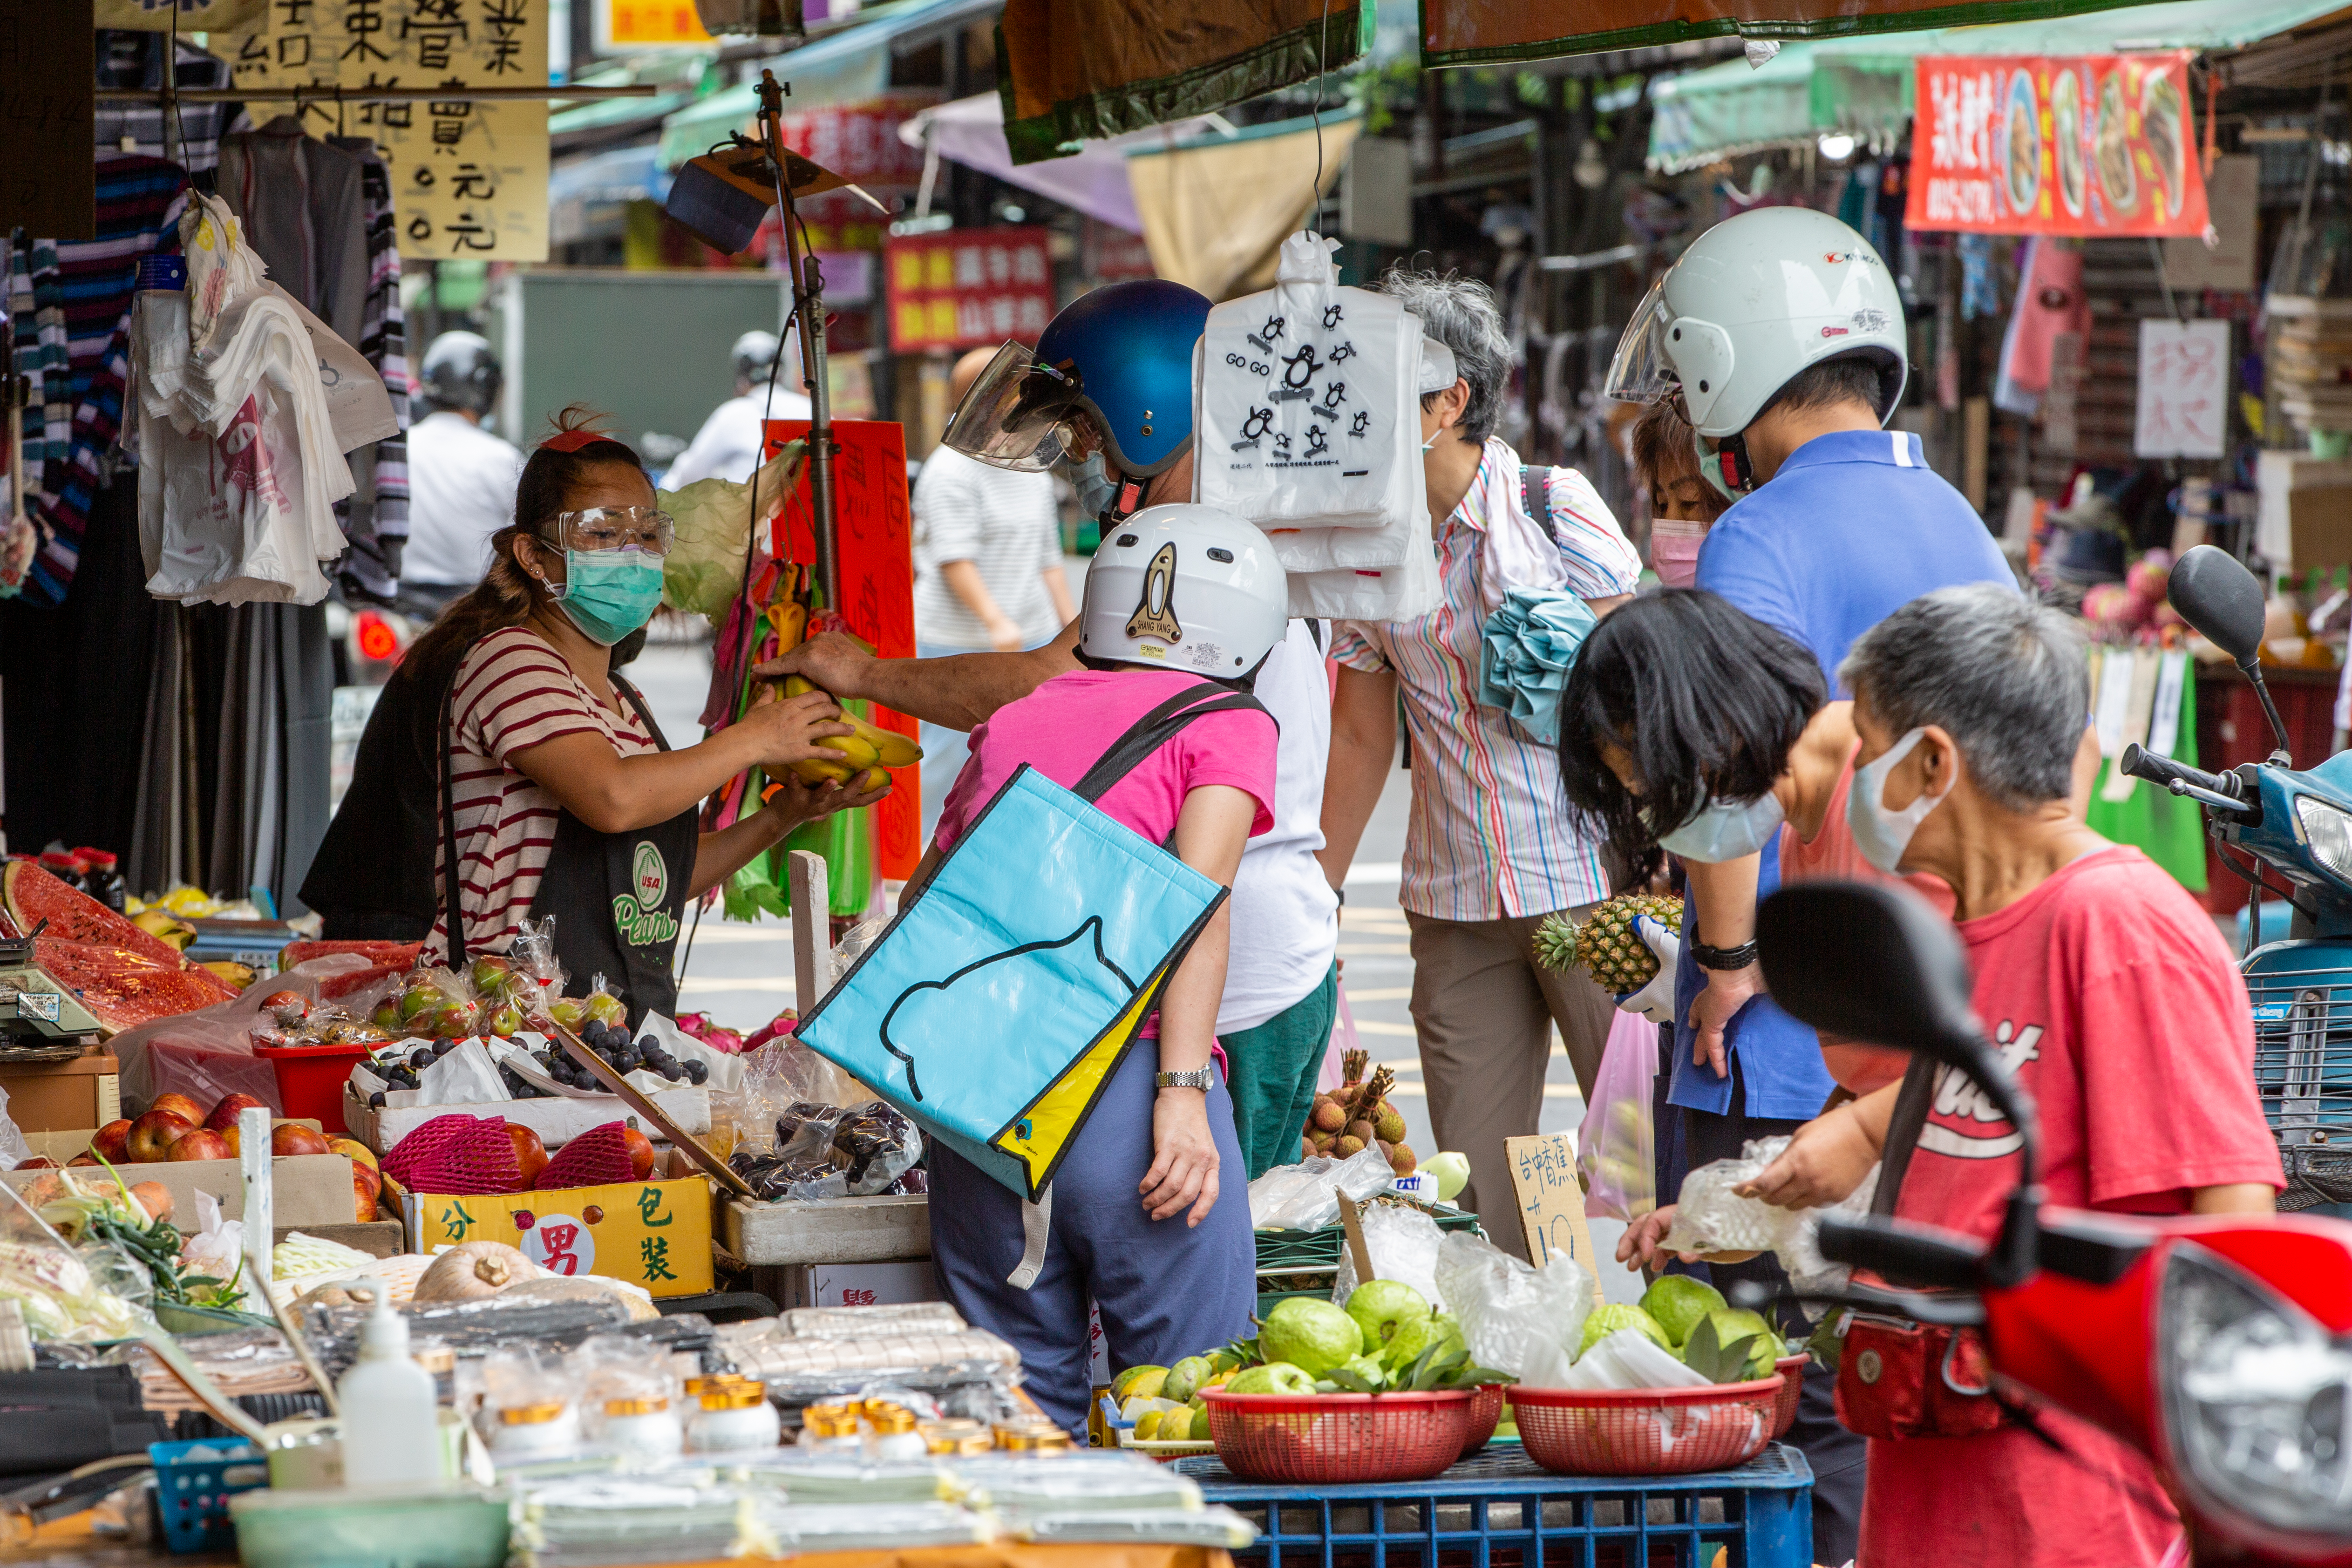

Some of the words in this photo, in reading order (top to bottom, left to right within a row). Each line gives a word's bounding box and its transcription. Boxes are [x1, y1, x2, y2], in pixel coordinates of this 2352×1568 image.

[236, 0, 527, 75] 結束營業
[1225, 353, 1246, 368] GO
[1250, 361, 1270, 376] GO
[1137, 620, 1154, 631] SHANG
[1156, 623, 1171, 634] YANG
[642, 875, 660, 889] USA
[612, 893, 678, 946] Pears
[440, 1200, 476, 1241] 分
[637, 1186, 678, 1282] 包裝
[539, 1222, 579, 1276] 男
